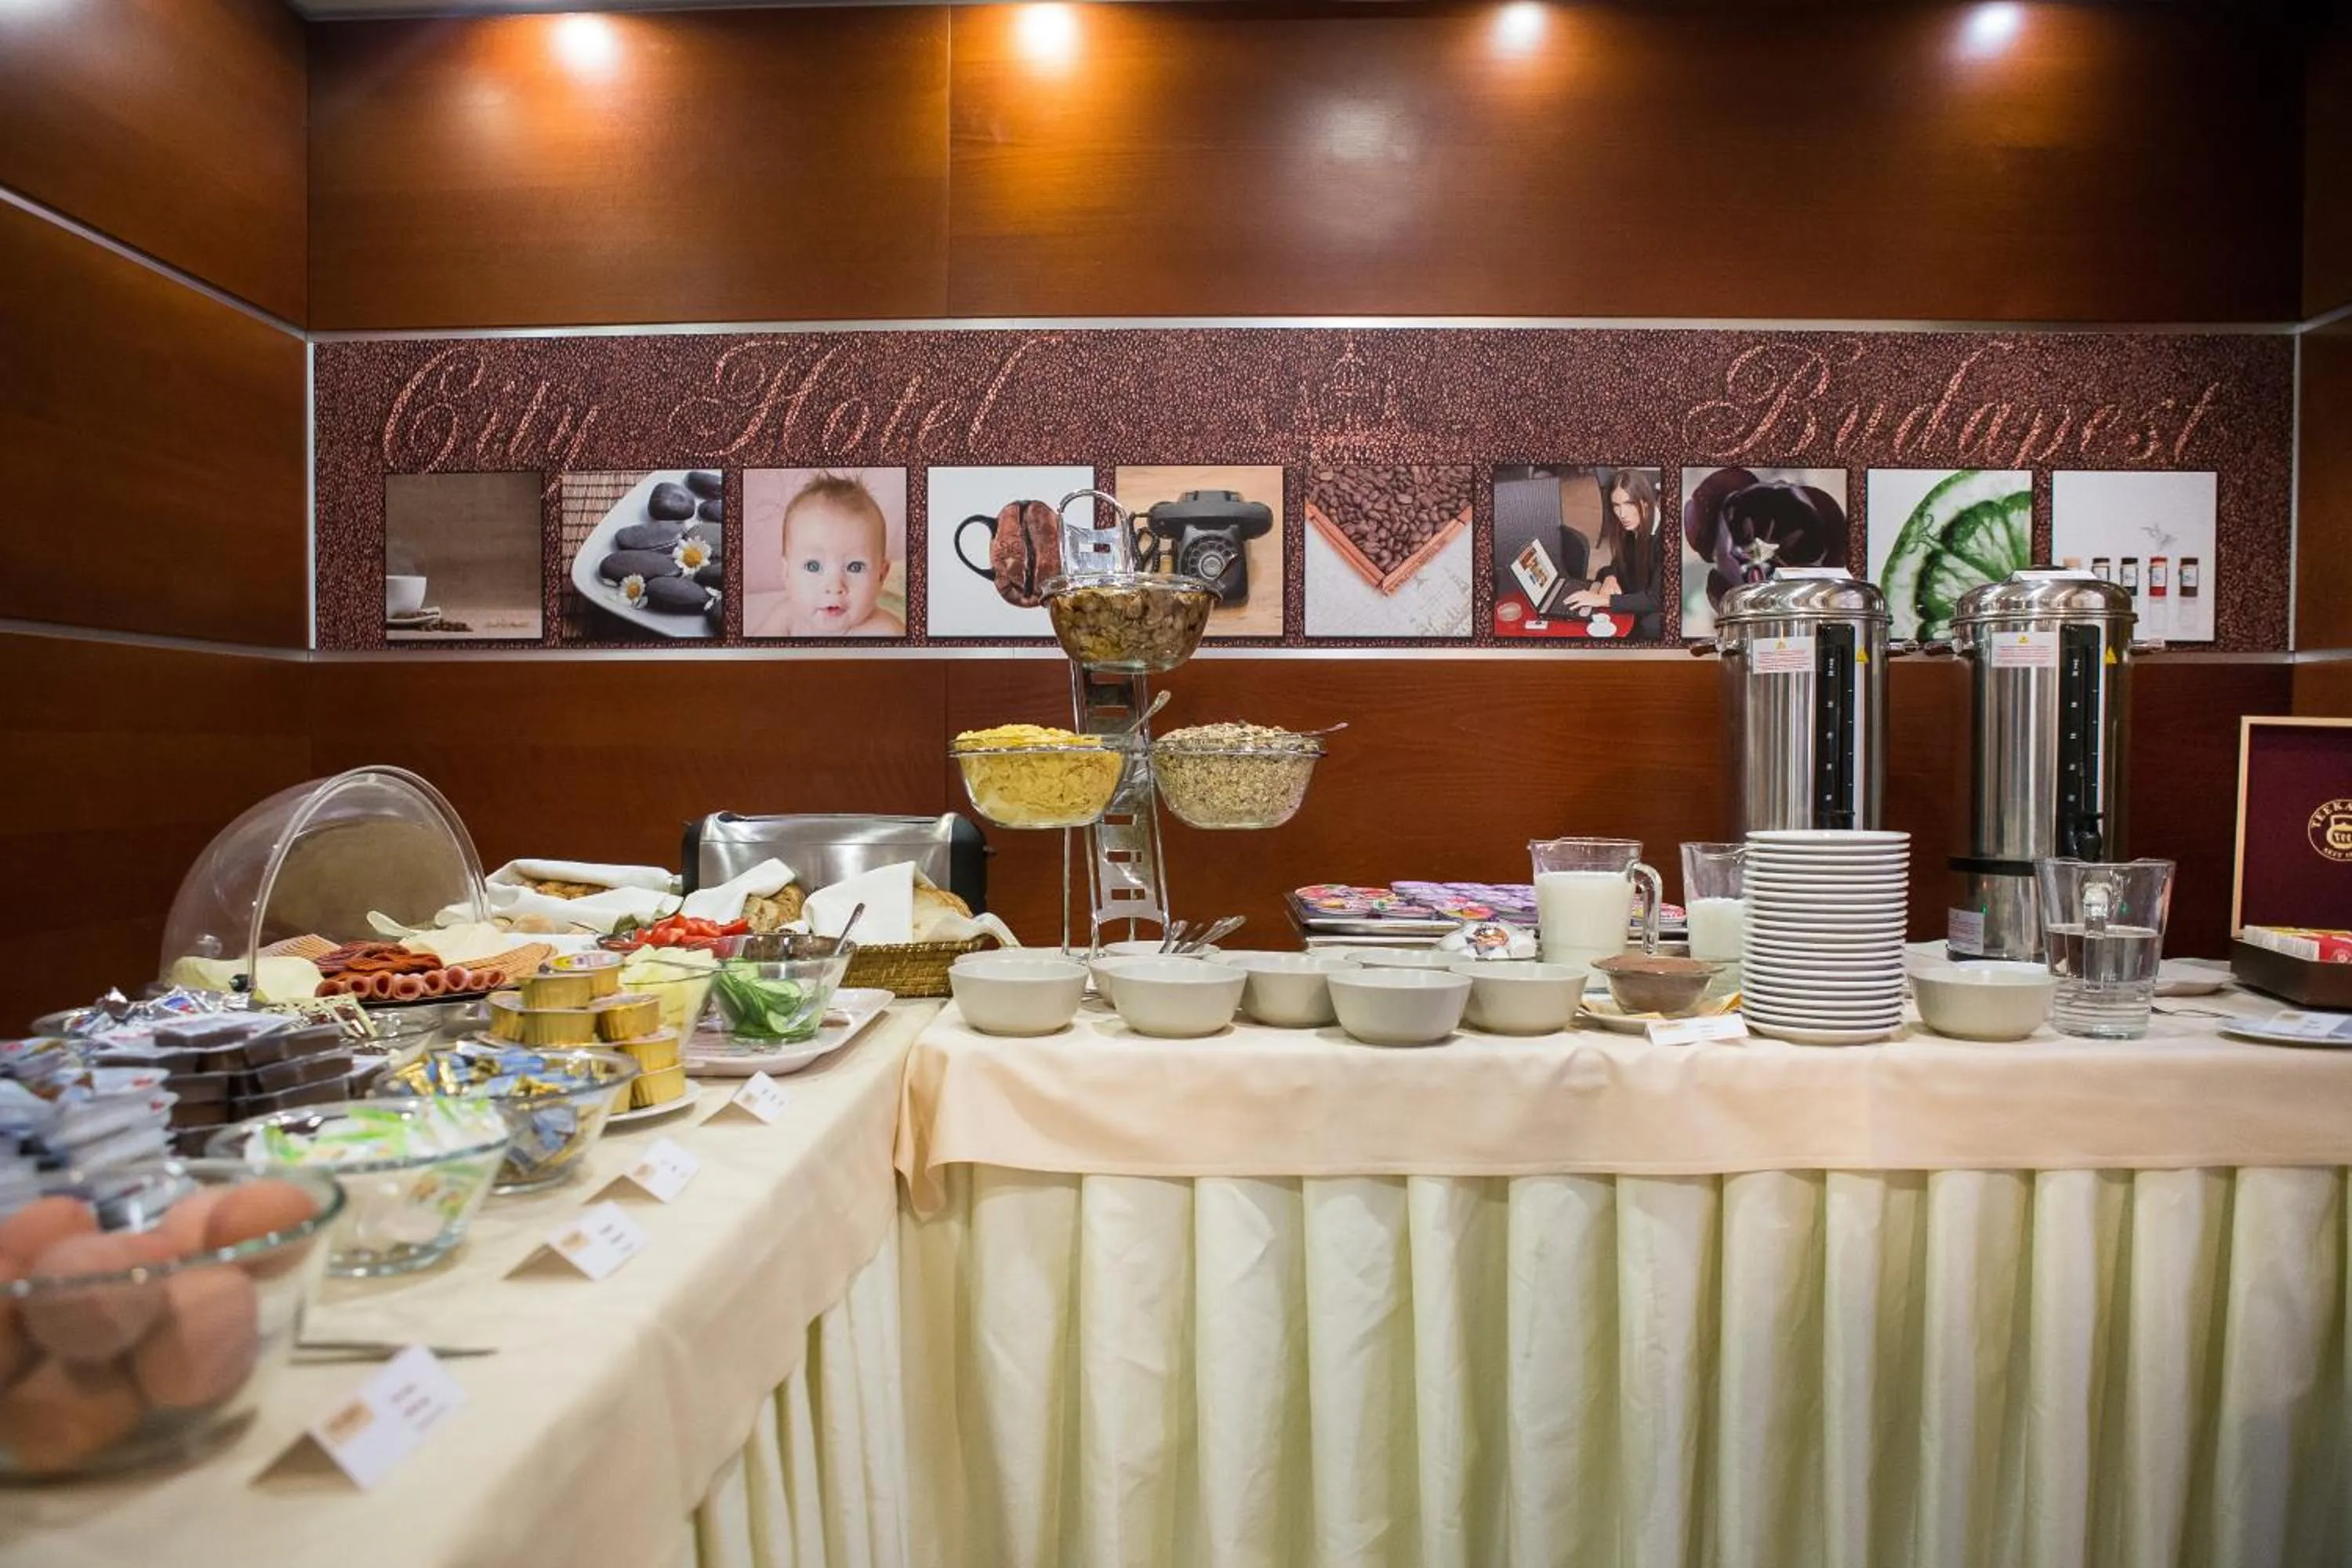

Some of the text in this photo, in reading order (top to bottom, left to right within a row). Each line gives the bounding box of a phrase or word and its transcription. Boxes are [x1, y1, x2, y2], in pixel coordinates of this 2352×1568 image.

[381, 336, 2222, 499] City Hotel Budapest
